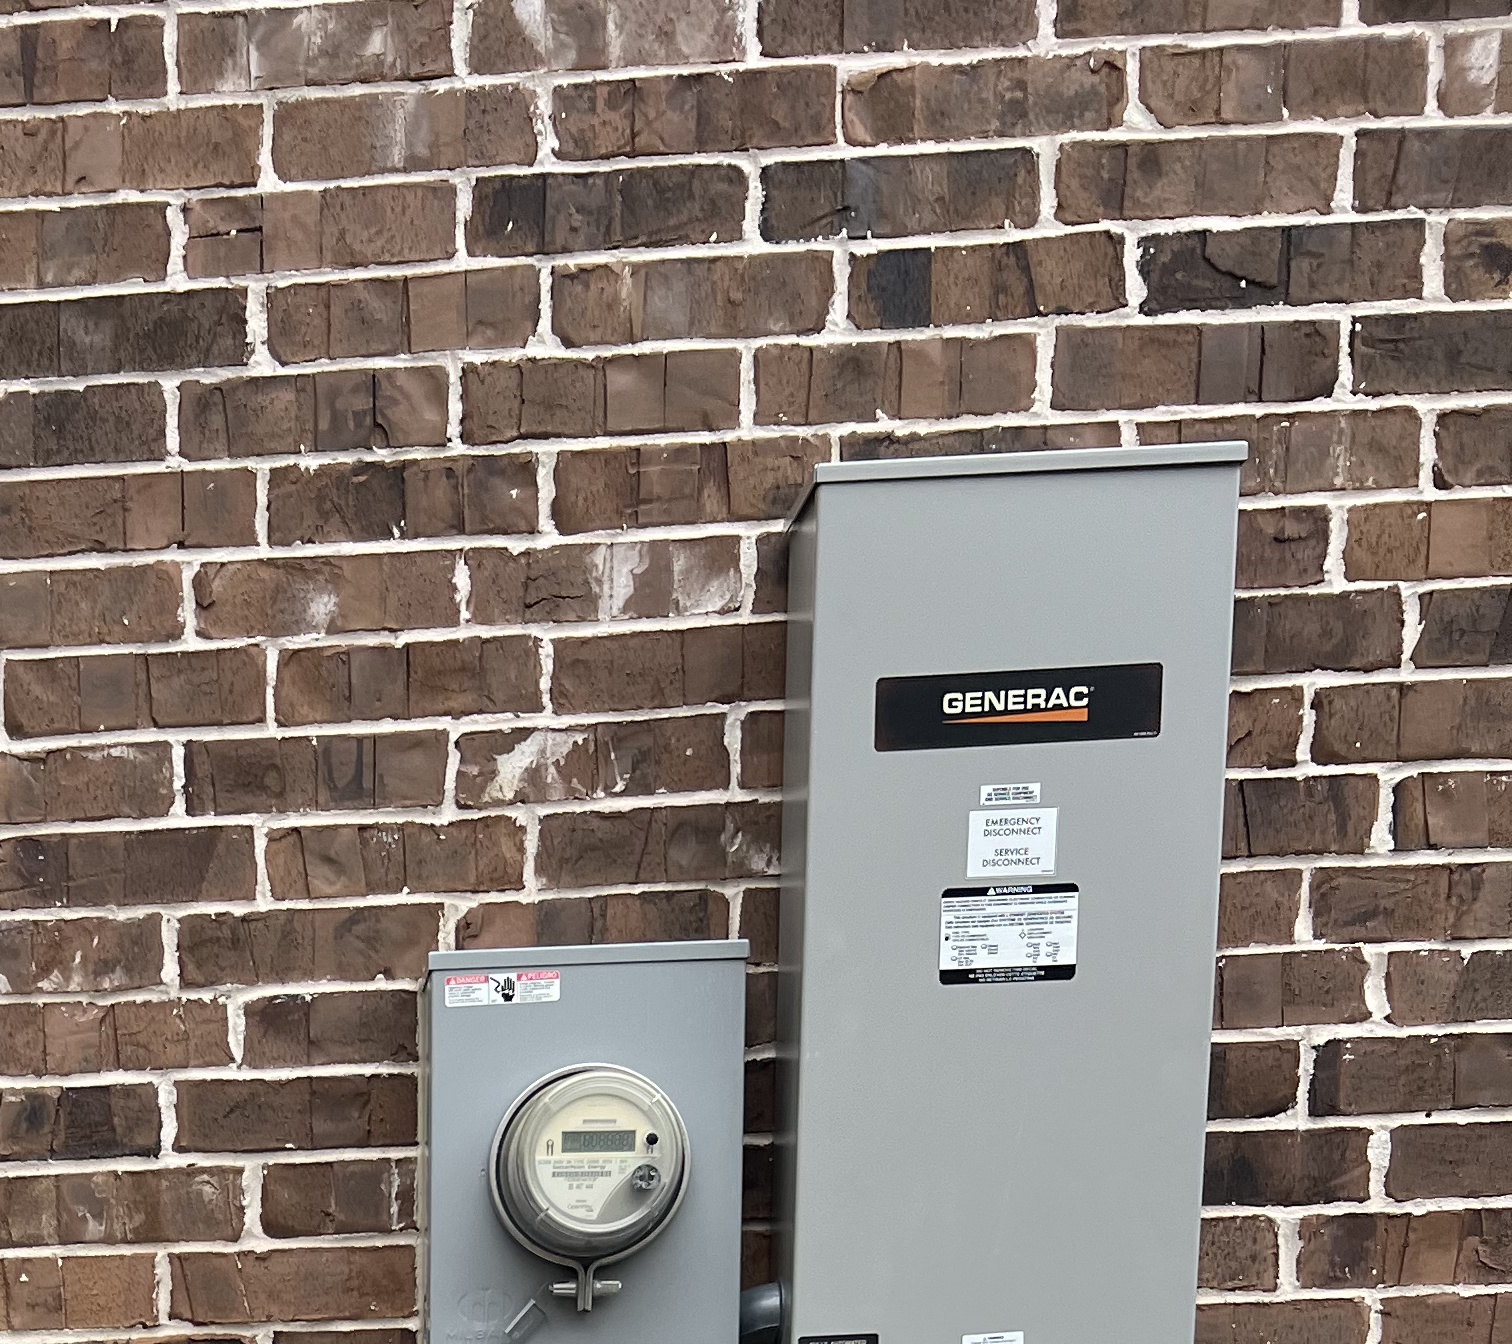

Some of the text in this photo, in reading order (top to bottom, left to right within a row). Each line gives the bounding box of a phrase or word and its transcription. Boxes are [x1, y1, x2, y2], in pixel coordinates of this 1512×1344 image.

[942, 685, 1089, 715] GENERAC
[985, 816, 1041, 827] EMERGENCY
[983, 826, 1042, 837] DISCONNECT
[994, 847, 1030, 857] SERVICE
[982, 857, 1041, 867] DISCONNECT
[995, 885, 1033, 894] WARNING
[456, 976, 486, 984] DANGER
[528, 971, 558, 980] PELIGRO
